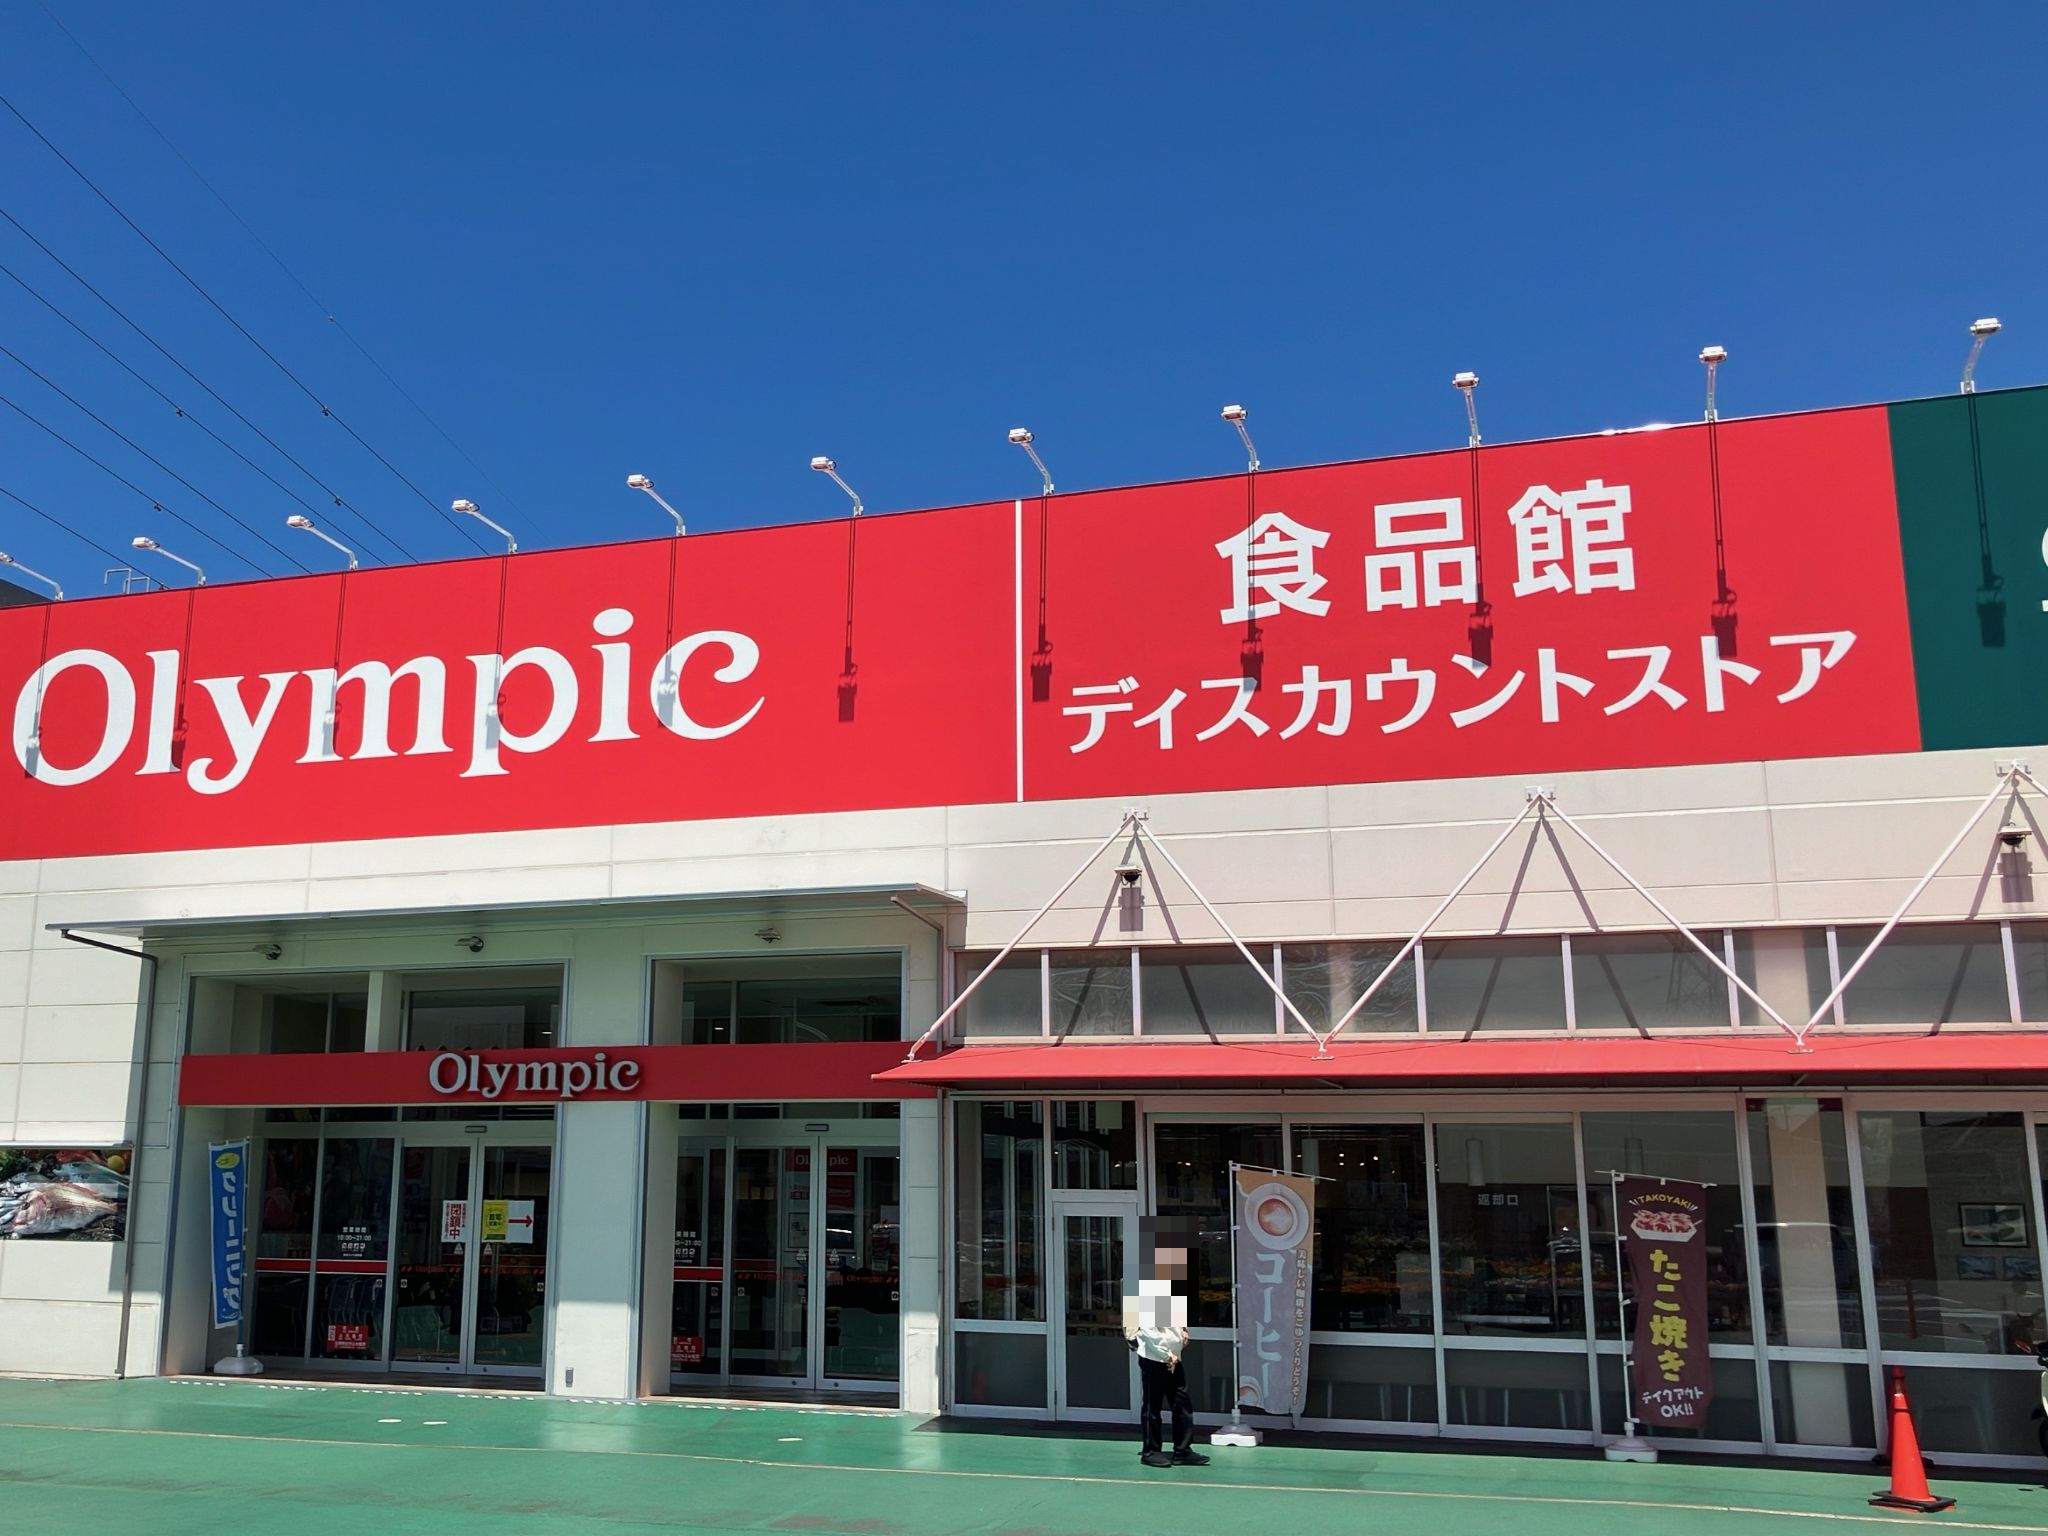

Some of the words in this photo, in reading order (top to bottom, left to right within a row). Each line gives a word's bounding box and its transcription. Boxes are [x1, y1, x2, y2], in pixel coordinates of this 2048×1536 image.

[1214, 477, 1637, 626] 食品館
[12, 608, 766, 796] Olympic
[1062, 629, 1858, 755] ディスカウントストア
[429, 1052, 641, 1099] Olympic
[795, 1153, 849, 1166] Olpic
[1637, 1193, 1692, 1209] TAKOYAKI
[1255, 1252, 1286, 1398] コーヒー
[1649, 1249, 1688, 1382] たこ焼き
[1642, 1387, 1704, 1404] テイクアウト
[1660, 1403, 1694, 1418] OK!!
